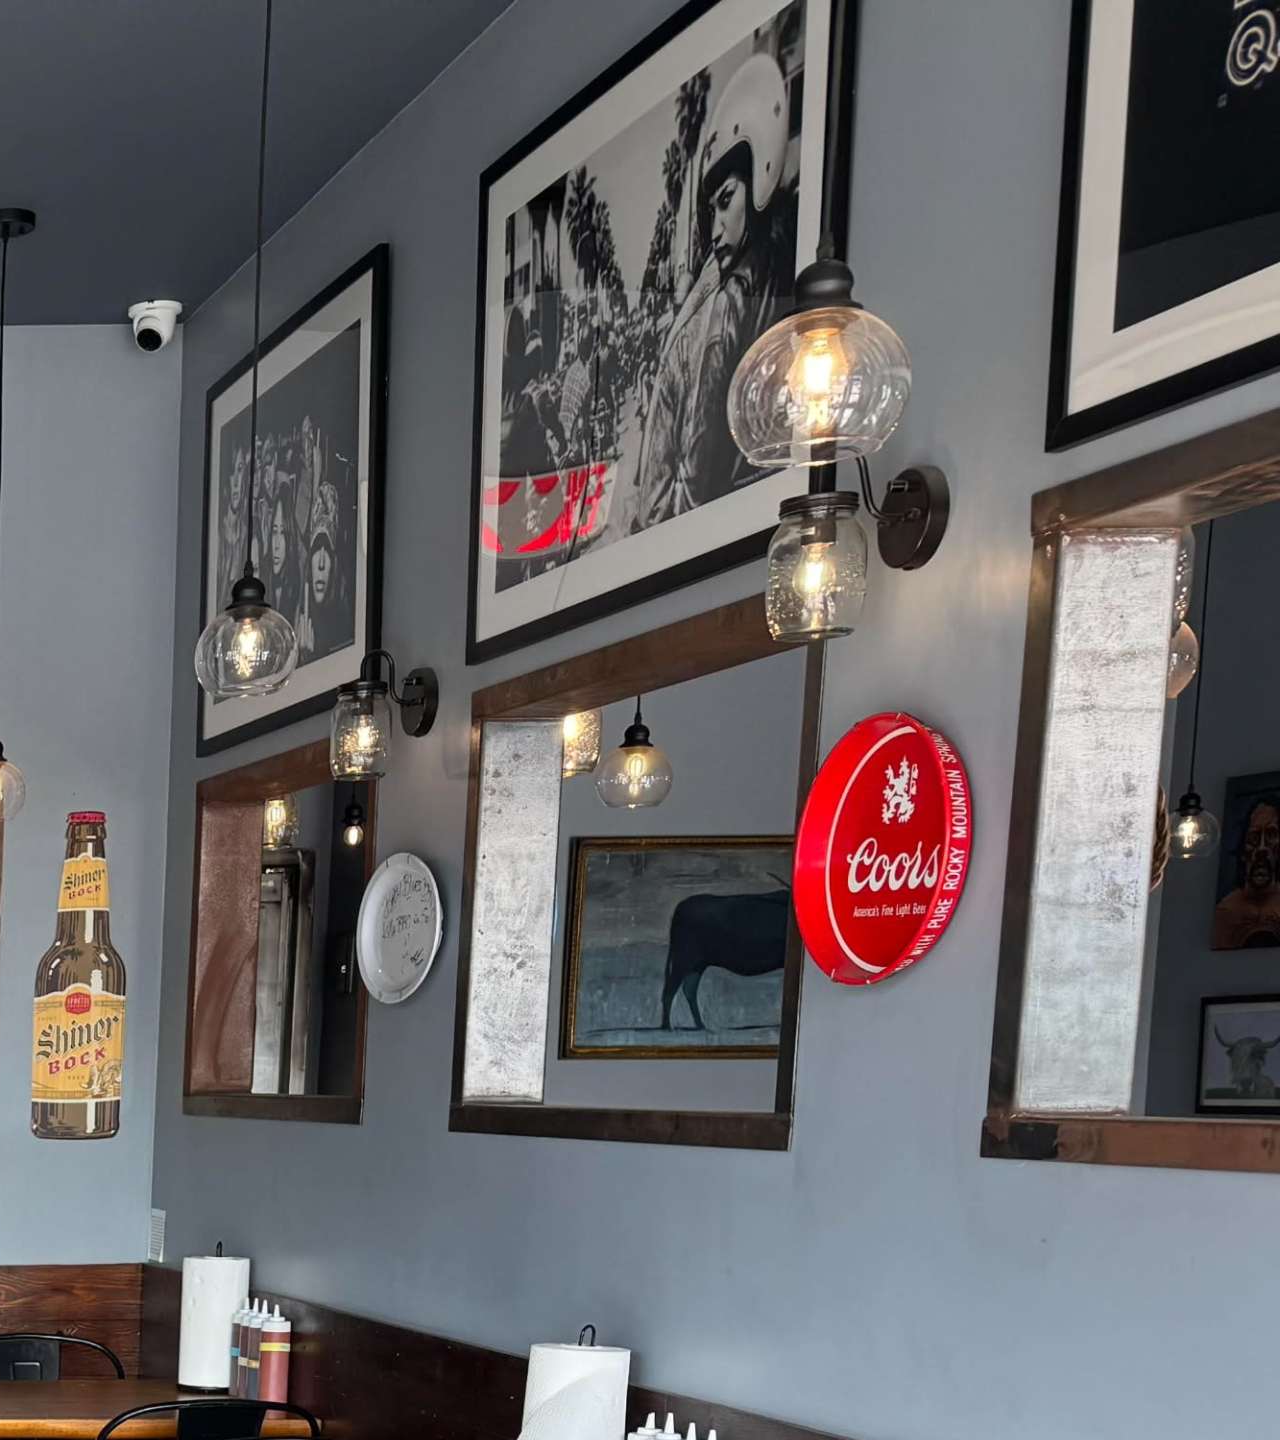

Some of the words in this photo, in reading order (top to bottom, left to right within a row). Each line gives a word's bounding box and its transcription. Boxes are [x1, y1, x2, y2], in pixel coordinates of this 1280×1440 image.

[947, 769, 968, 839] MOUNTAIN
[64, 868, 105, 891] Shiner
[846, 837, 941, 893] Coors
[942, 847, 966, 891] ROCKY
[68, 884, 102, 901] BOCK
[881, 904, 894, 917] Fine
[896, 903, 911, 918] Light
[913, 902, 927, 916] Beer
[926, 897, 953, 929] PURE
[36, 1015, 119, 1059] Shiner
[48, 1047, 107, 1075] BOCK
